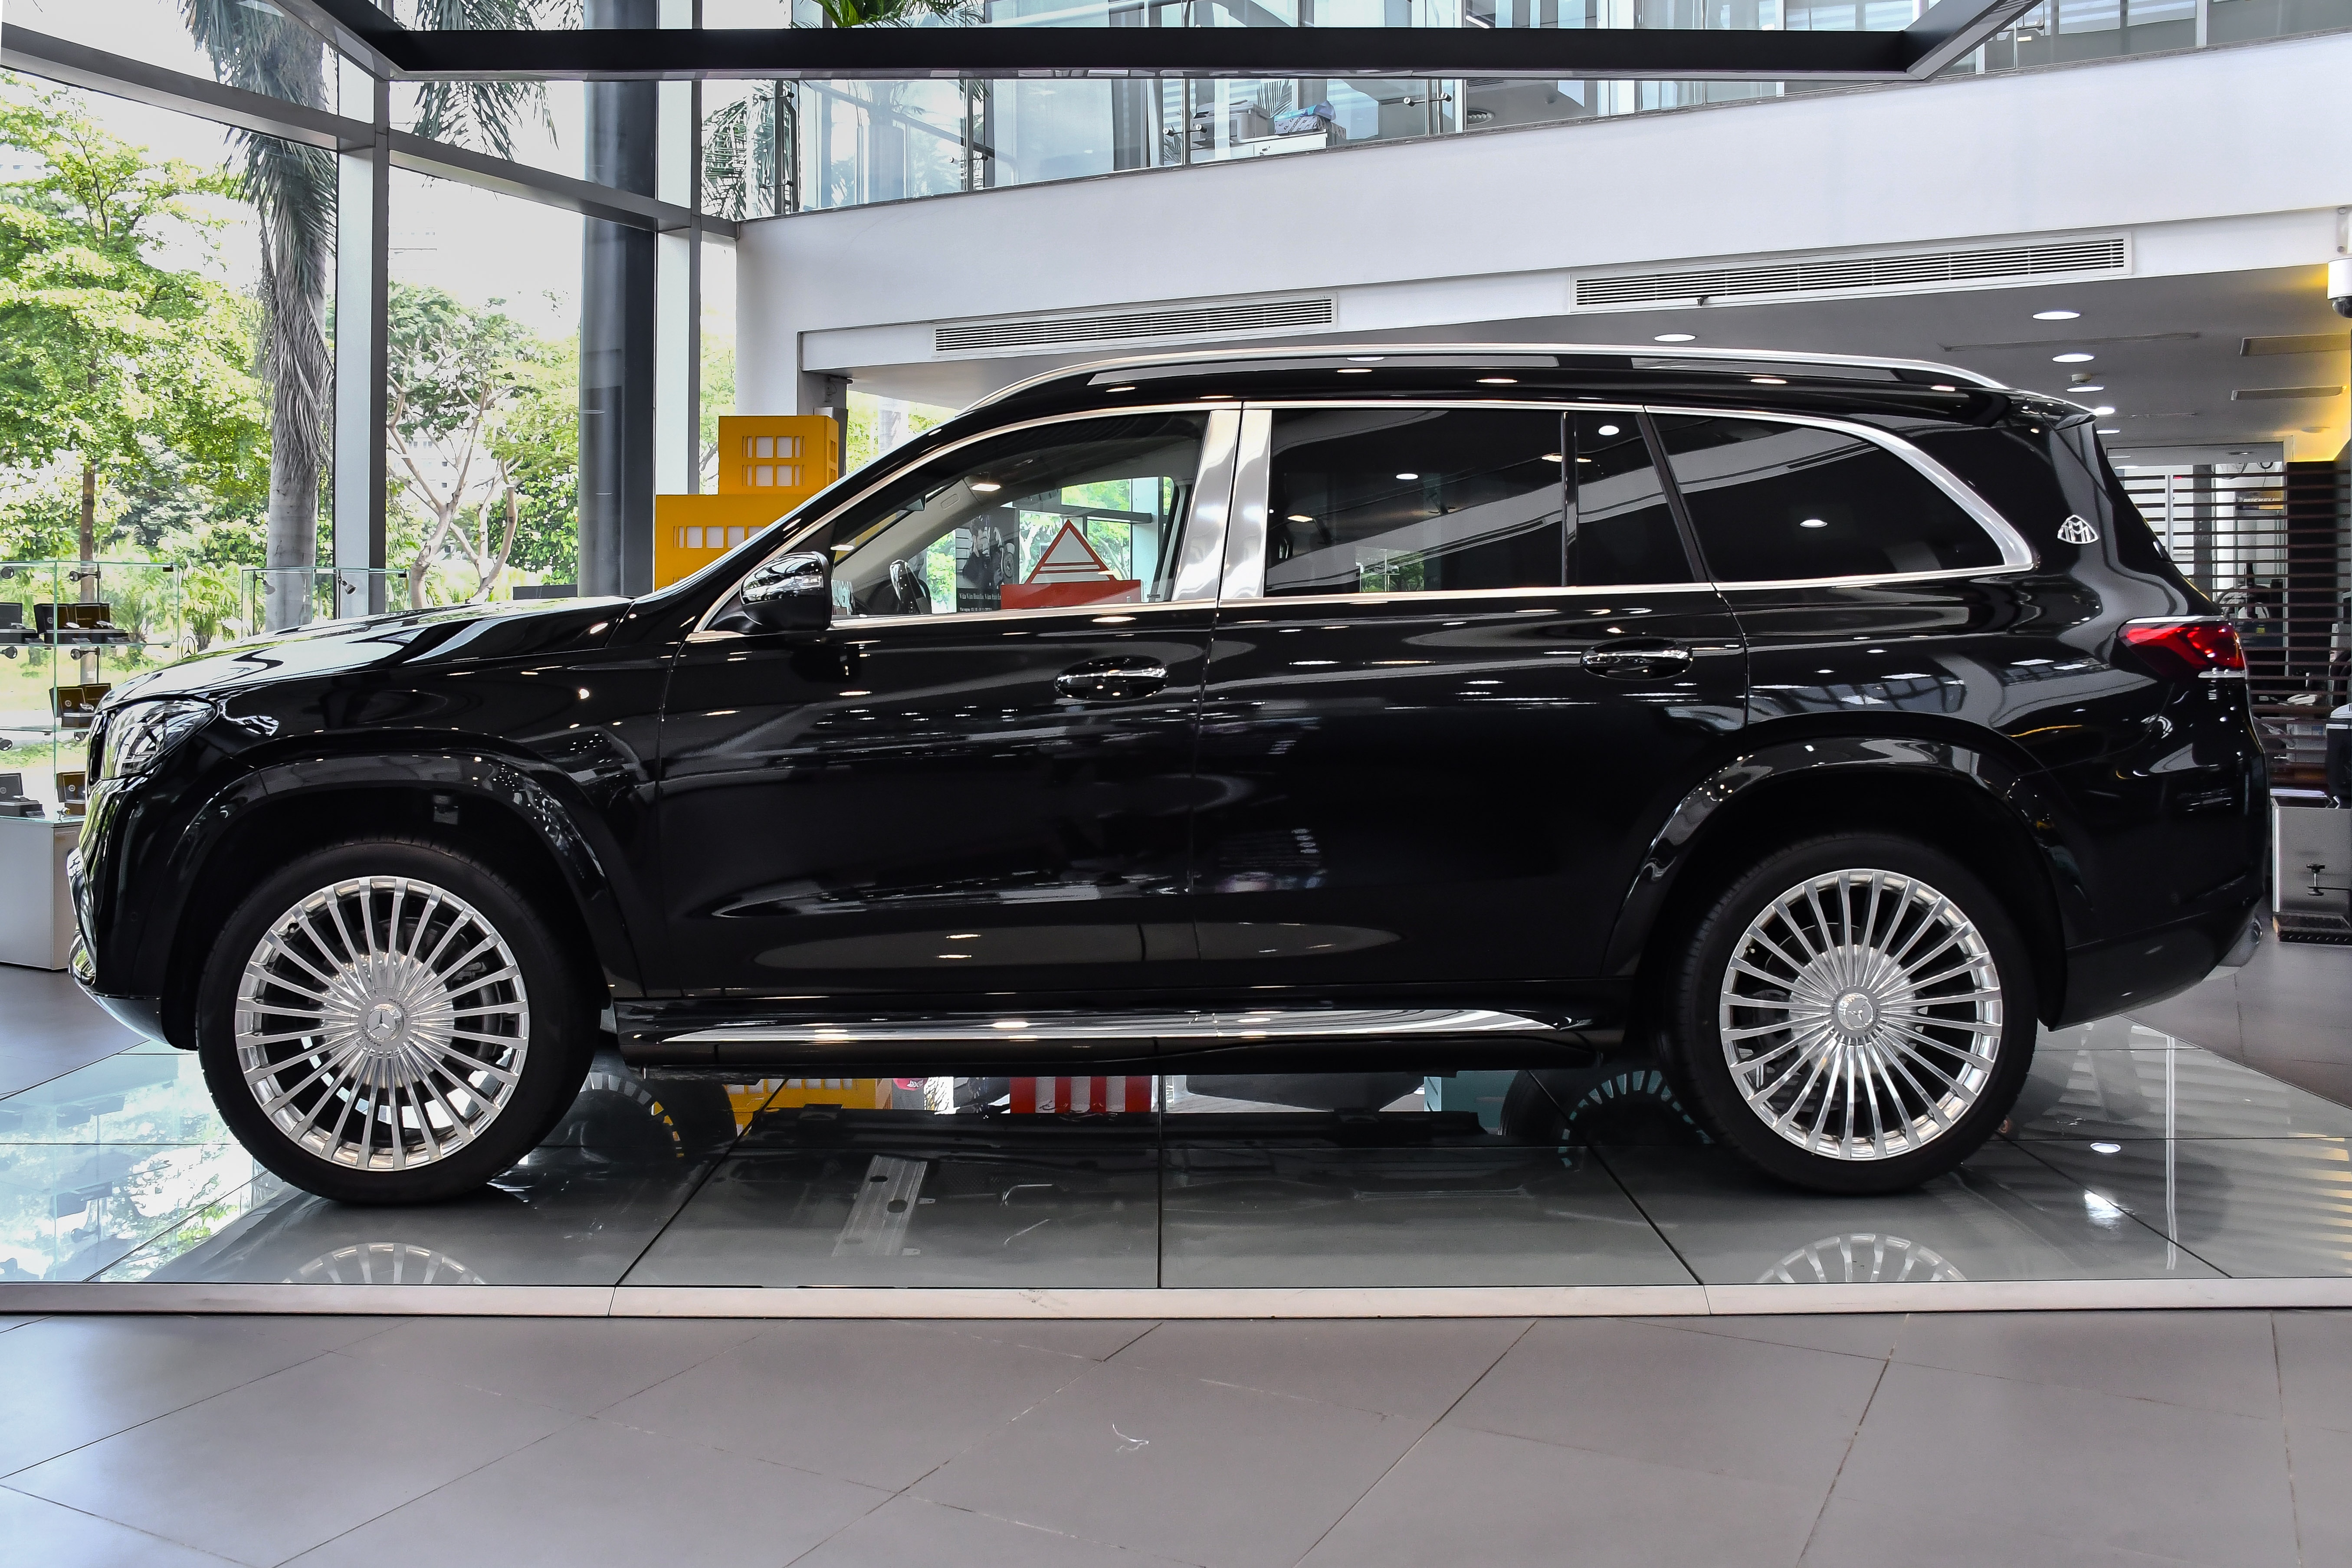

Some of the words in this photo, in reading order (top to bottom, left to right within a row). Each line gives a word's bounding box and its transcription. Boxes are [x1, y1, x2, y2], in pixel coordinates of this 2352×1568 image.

[389, 998, 409, 1019] MAYBACH
[1832, 991, 1846, 1014] MAYBACH
[361, 1027, 381, 1046] MAYBACH
